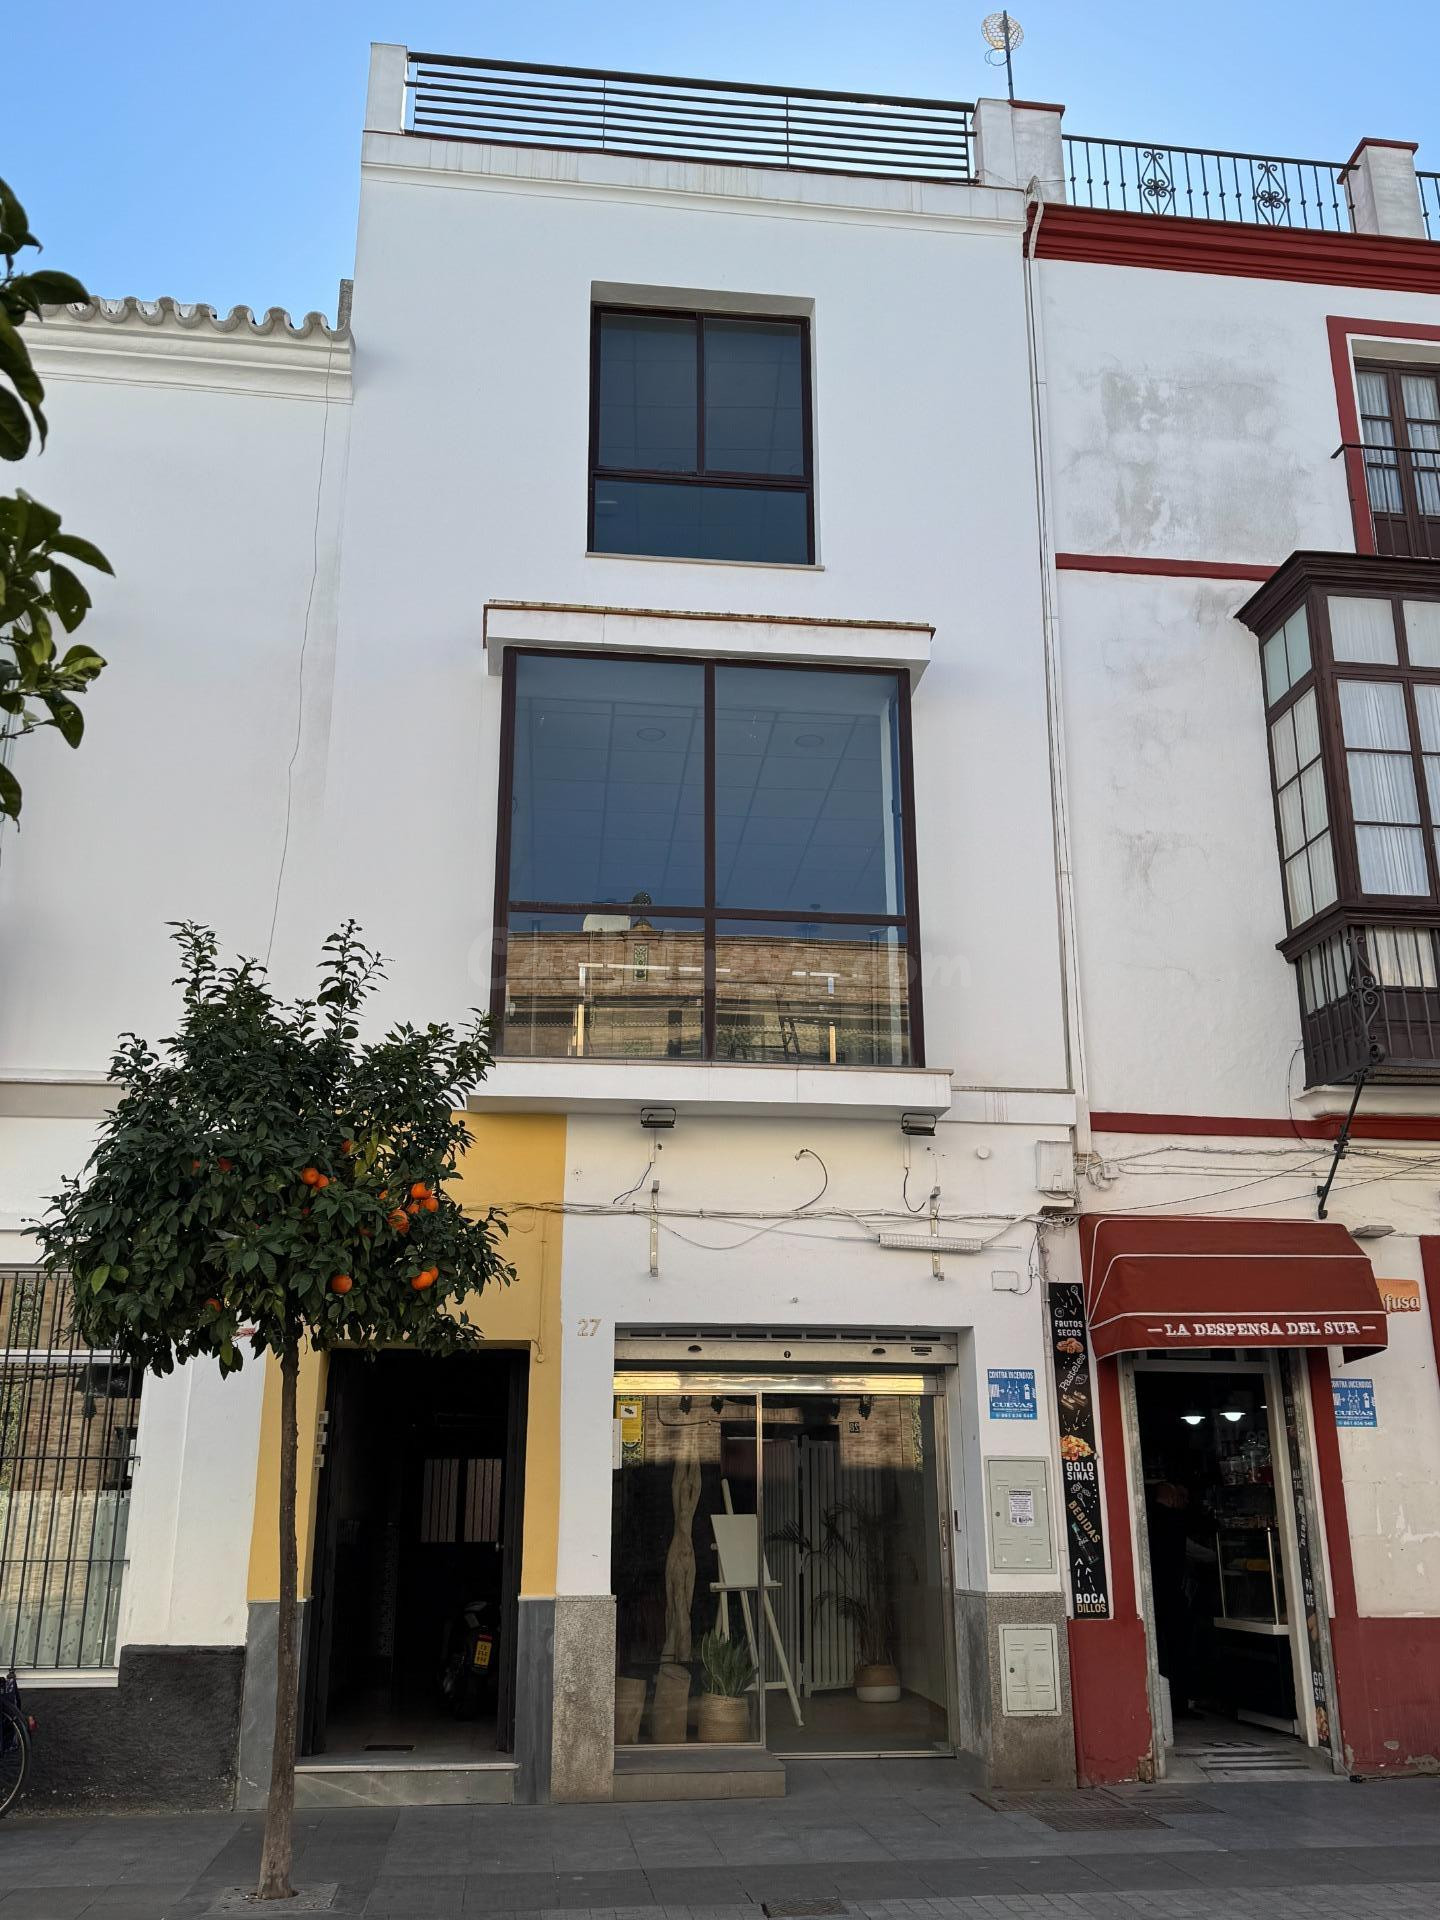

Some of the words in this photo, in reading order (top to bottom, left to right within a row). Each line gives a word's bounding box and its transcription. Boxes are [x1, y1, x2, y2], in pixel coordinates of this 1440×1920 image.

[577, 1318, 601, 1336] 27
[1164, 1323, 1190, 1336] LA
[1193, 1322, 1284, 1336] DESPENSA
[1286, 1322, 1322, 1335] DEL
[1324, 1321, 1360, 1334] SUR
[1057, 1329, 1082, 1337] SECOS
[1059, 1352, 1086, 1392] Pasteles
[1066, 1462, 1094, 1472] GOLO
[1067, 1472, 1095, 1480] SINAS
[1068, 1500, 1100, 1543] BEBIDAS
[1076, 1593, 1105, 1603] BOCA
[1077, 1603, 1106, 1613] DILLOS
